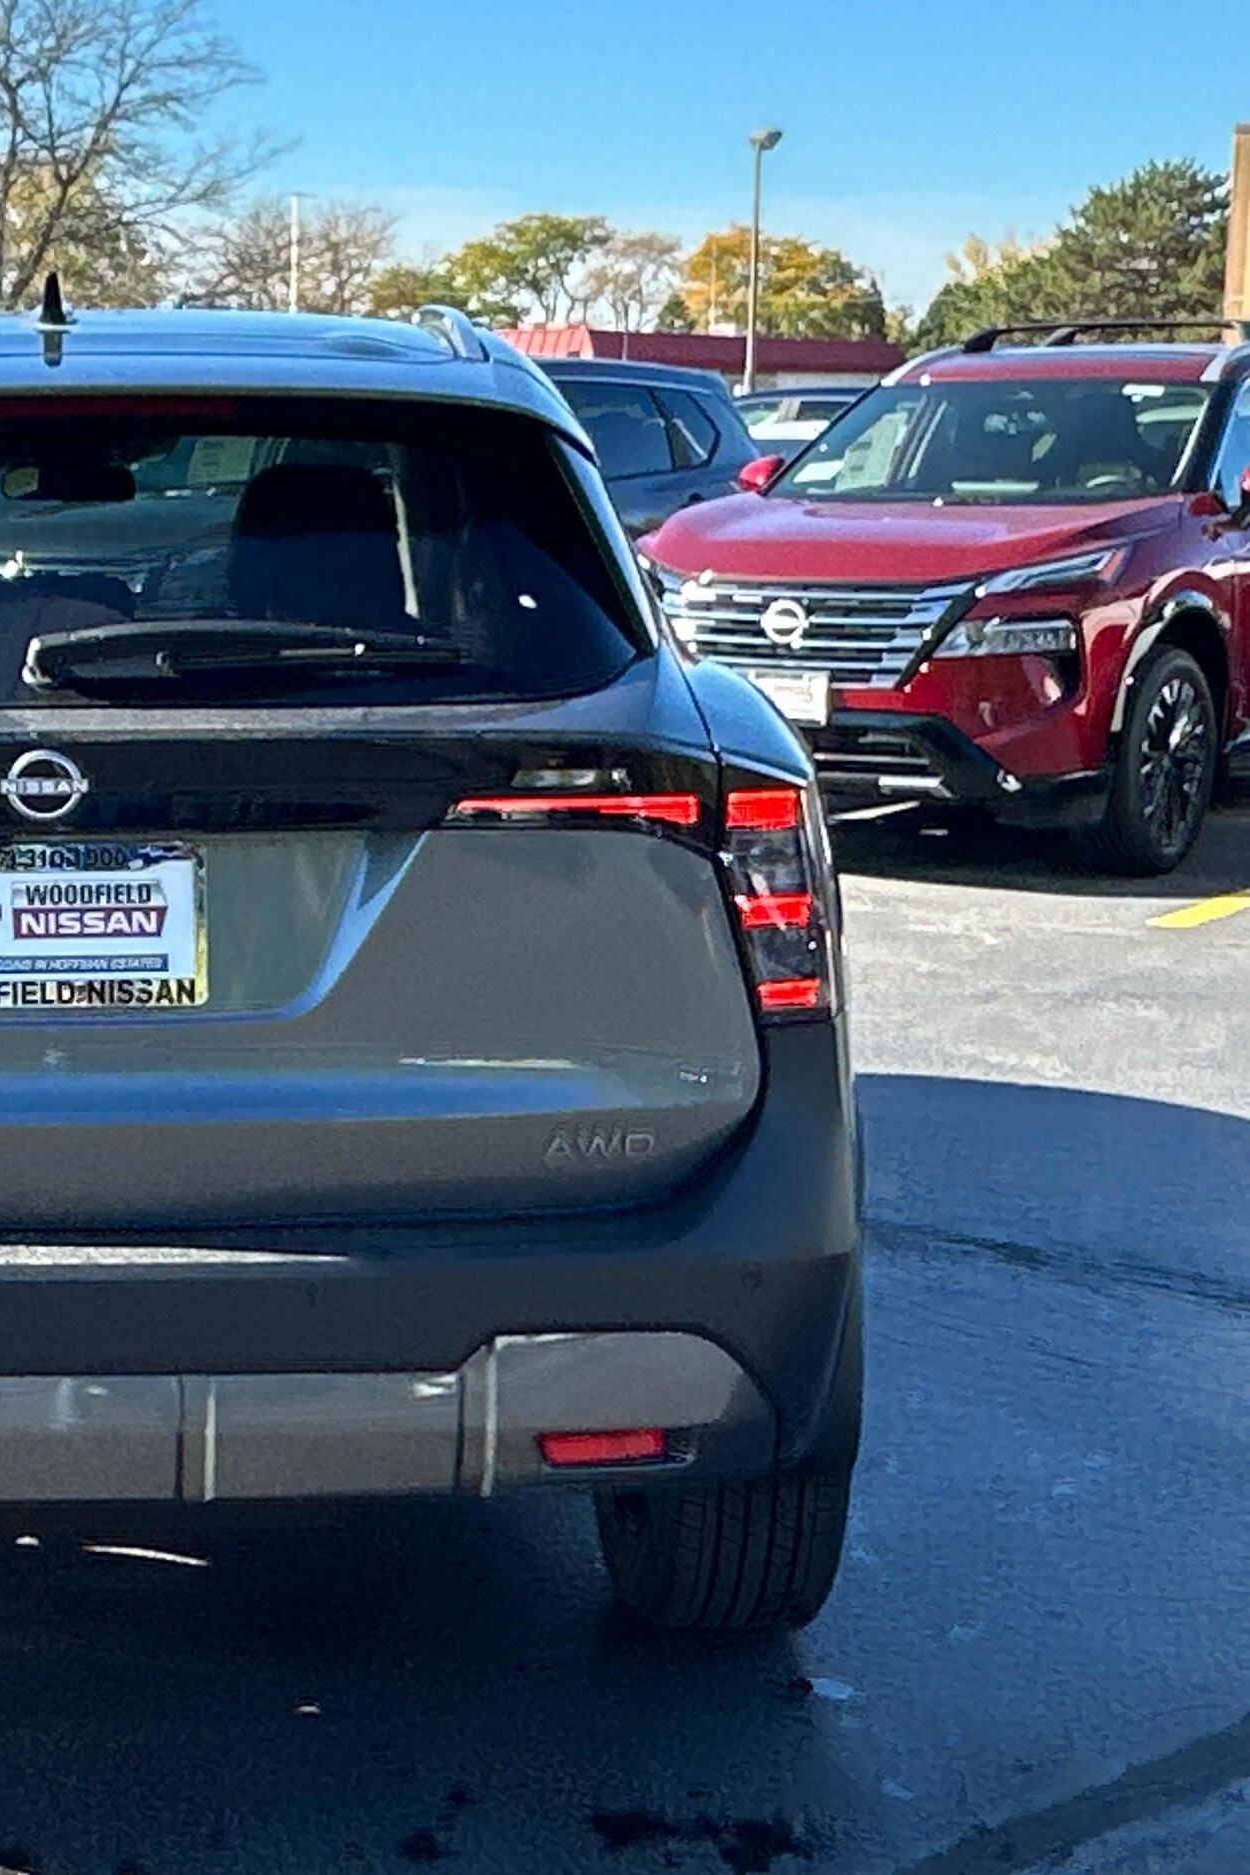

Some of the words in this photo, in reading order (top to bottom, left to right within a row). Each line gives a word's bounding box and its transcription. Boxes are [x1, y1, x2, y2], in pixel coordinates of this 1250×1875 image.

[26, 883, 152, 906] WOODFIELD
[20, 910, 158, 935] NISSAN
[86, 978, 197, 1005] NISSAN
[543, 1124, 657, 1160] AWD
